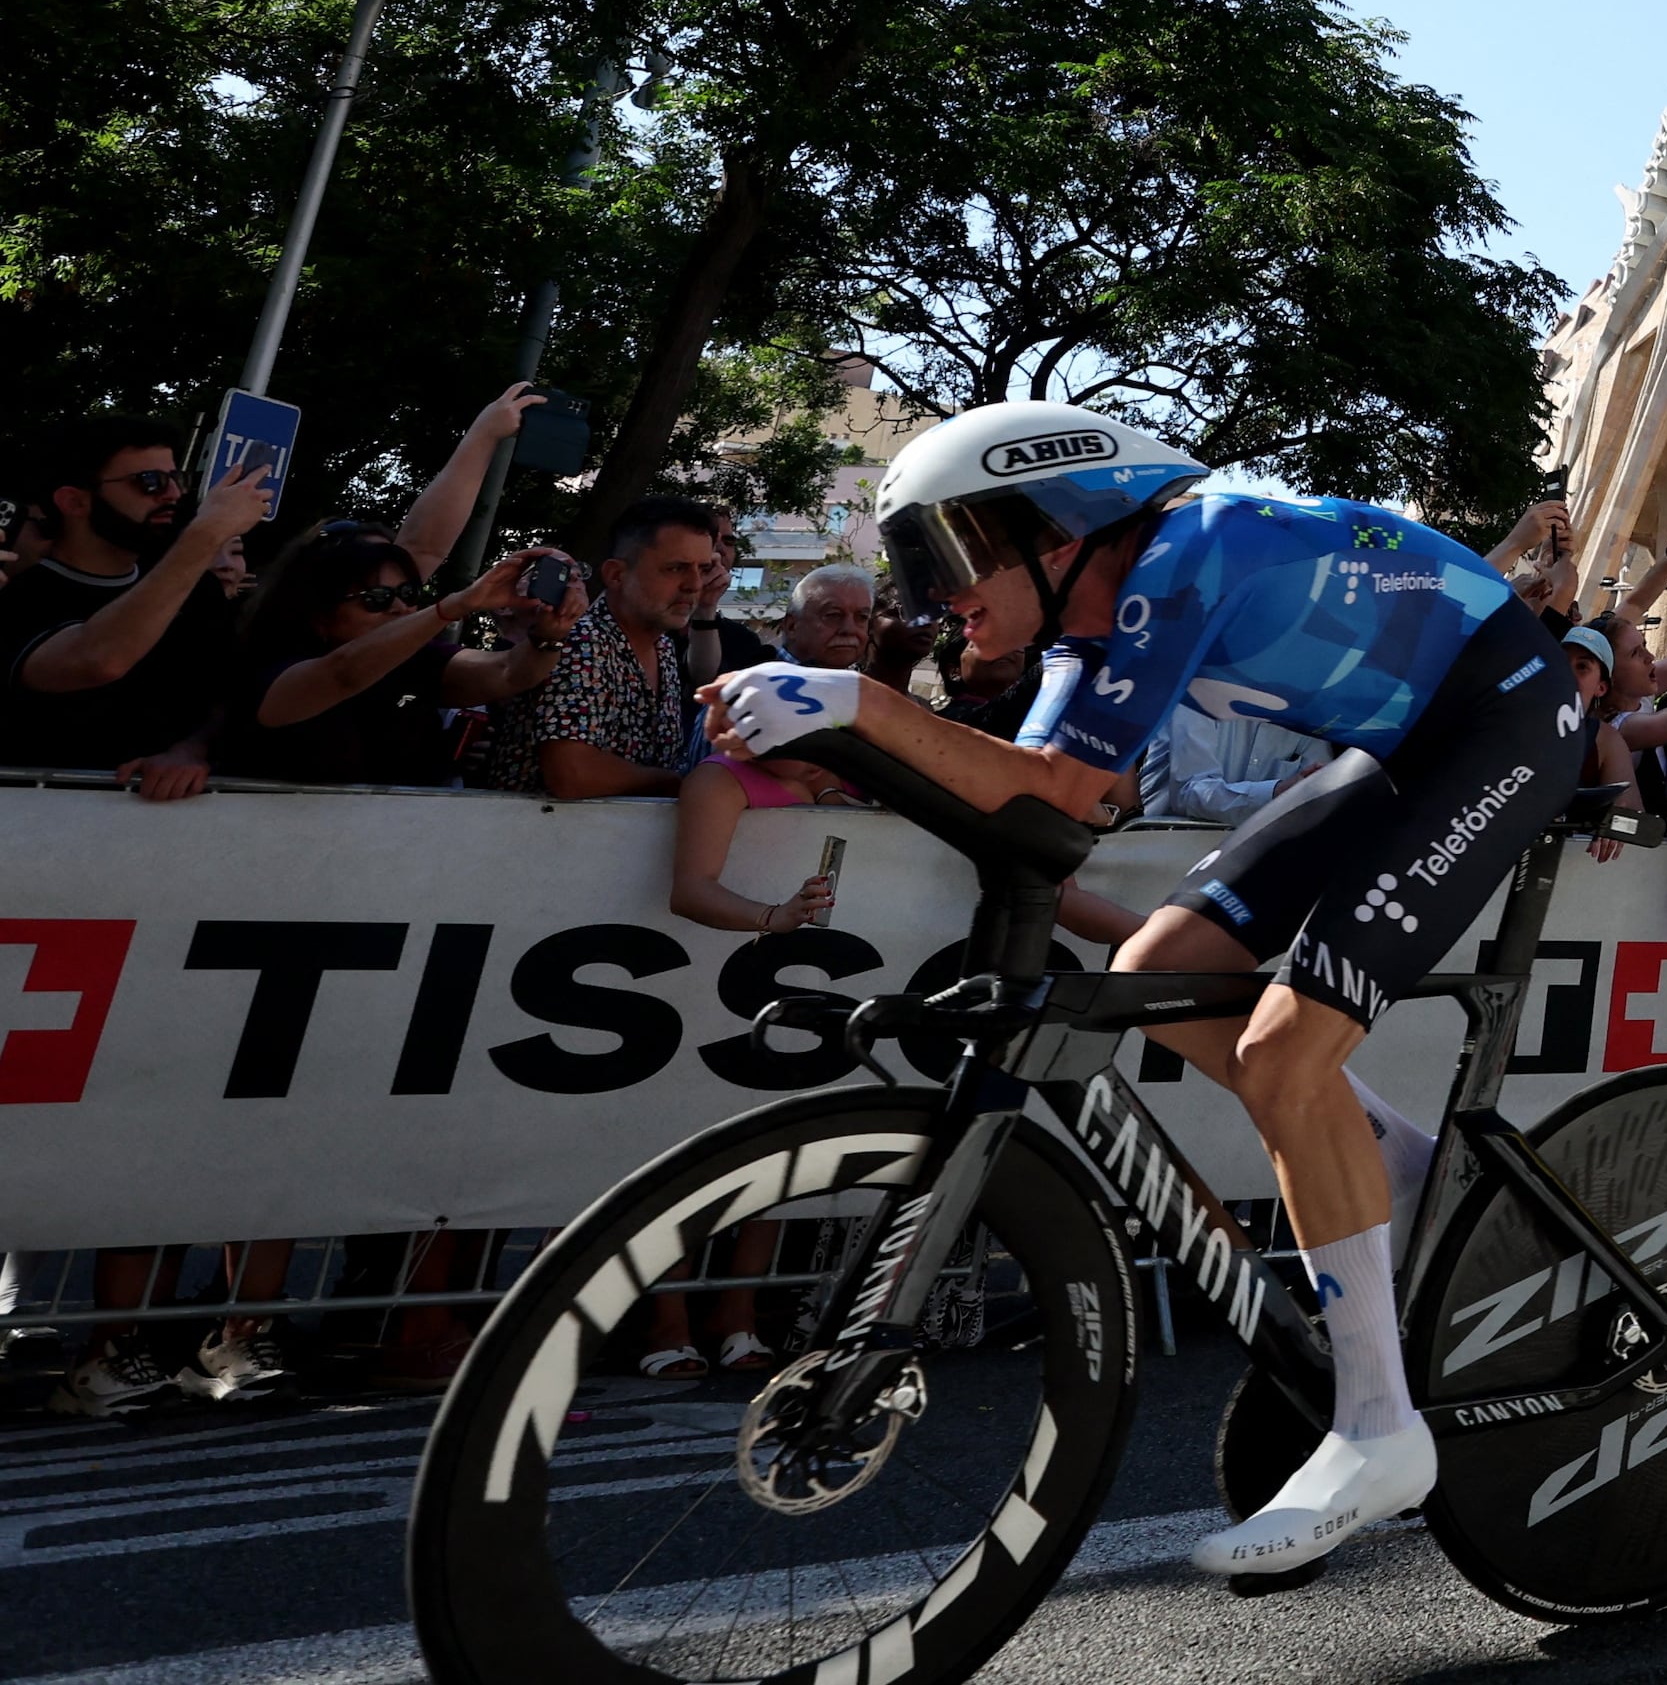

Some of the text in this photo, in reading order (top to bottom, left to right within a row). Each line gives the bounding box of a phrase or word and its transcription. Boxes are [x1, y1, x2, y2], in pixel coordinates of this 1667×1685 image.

[1003, 435, 1104, 469] ABUS
[1372, 570, 1446, 594] Telefónica
[1501, 657, 1544, 691] GOBIK
[1406, 762, 1535, 888] Telefónica
[1203, 881, 1251, 924] GOBIK
[184, 920, 1188, 1100] TISSO
[1077, 1072, 1268, 1347] CANYON
[823, 1191, 934, 1372] CANYON
[1077, 1281, 1104, 1383] ZIPP
[1454, 1394, 1565, 1427] CANYON
[1312, 1507, 1361, 1541] GOBIK
